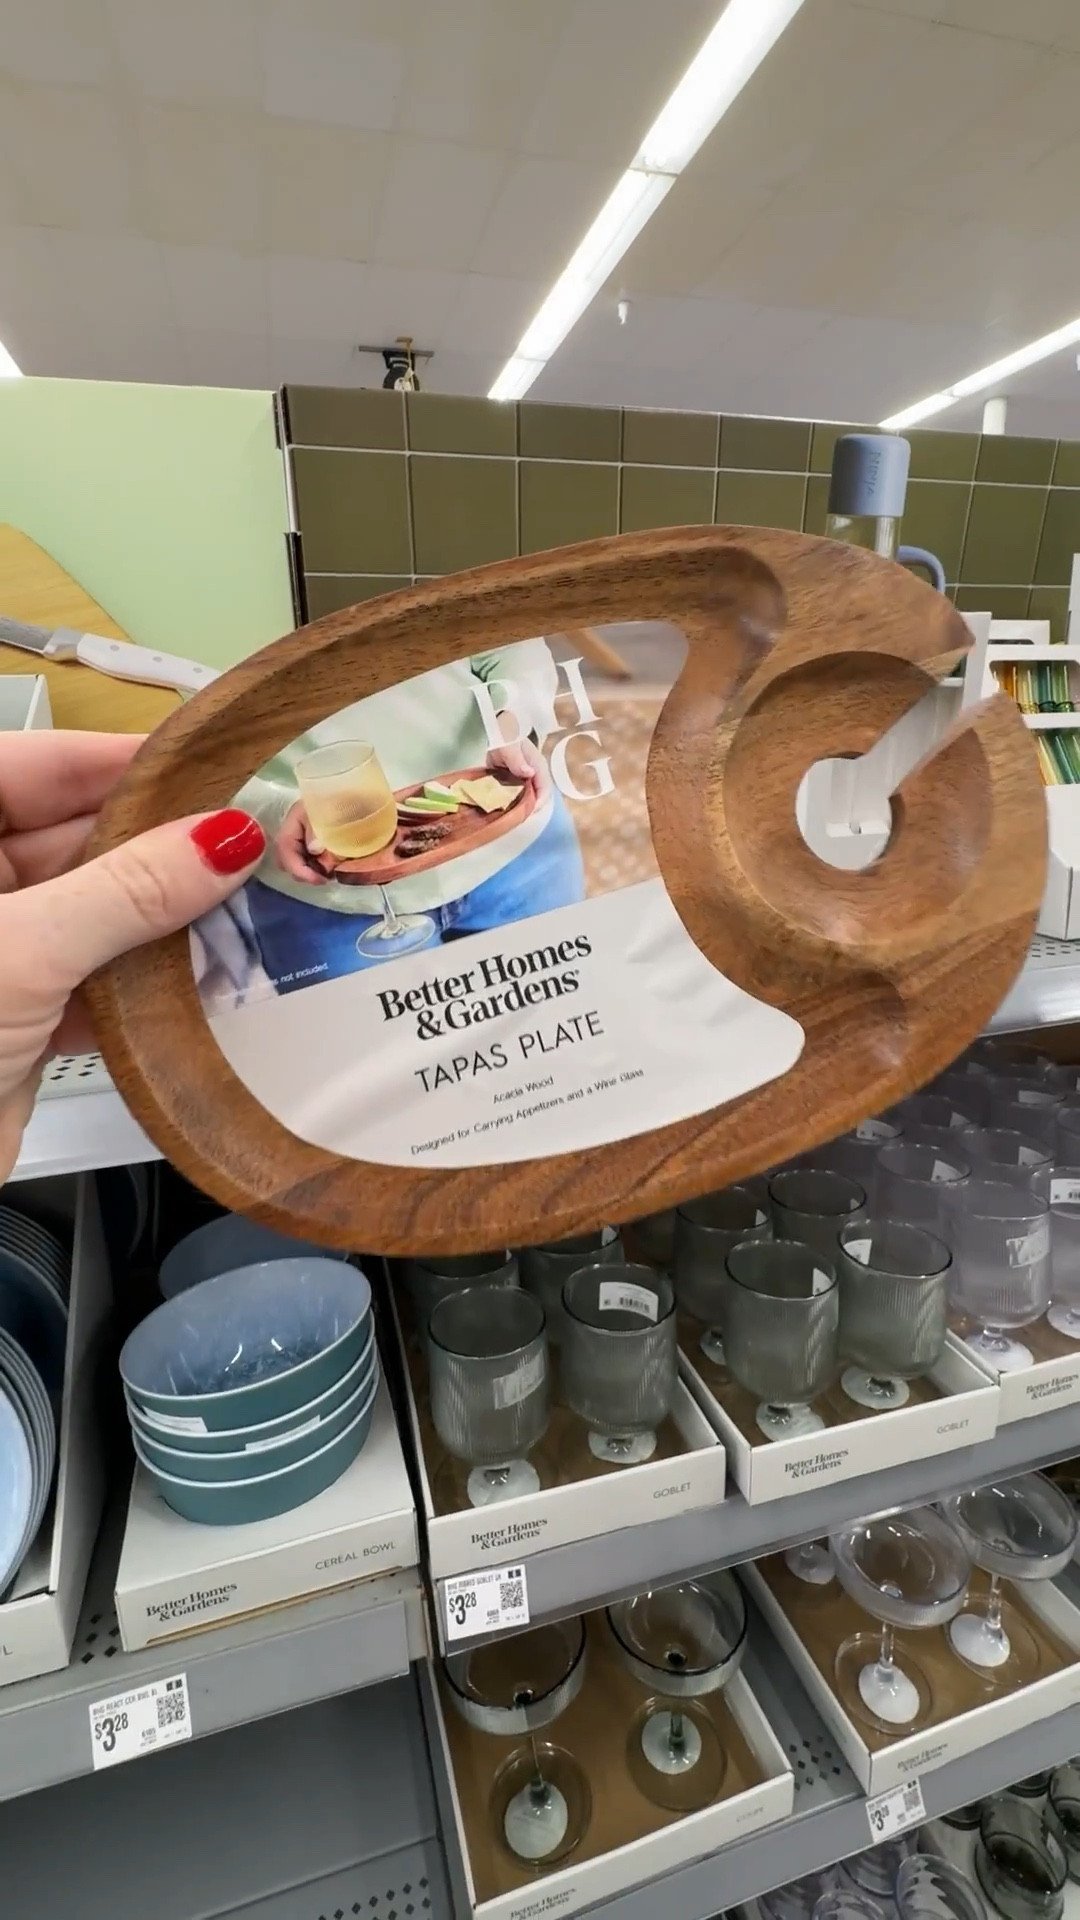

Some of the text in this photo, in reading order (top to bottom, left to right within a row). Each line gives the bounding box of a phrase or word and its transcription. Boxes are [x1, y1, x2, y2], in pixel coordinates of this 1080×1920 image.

[280, 973, 295, 982] not
[376, 934, 592, 1021] Better Homes
[414, 1010, 604, 1093] TAPAS PLATE
[493, 1076, 554, 1104] Acacia Wood
[411, 1069, 644, 1155] Designed for Carrying Appetizers and a Wine Glass
[784, 1449, 849, 1472] Better Homes
[653, 1482, 691, 1499] GOBLET
[471, 1518, 547, 1543] Better Homes
[315, 1541, 396, 1570] CEREAL BOWL
[146, 1583, 238, 1617] Better Homes
